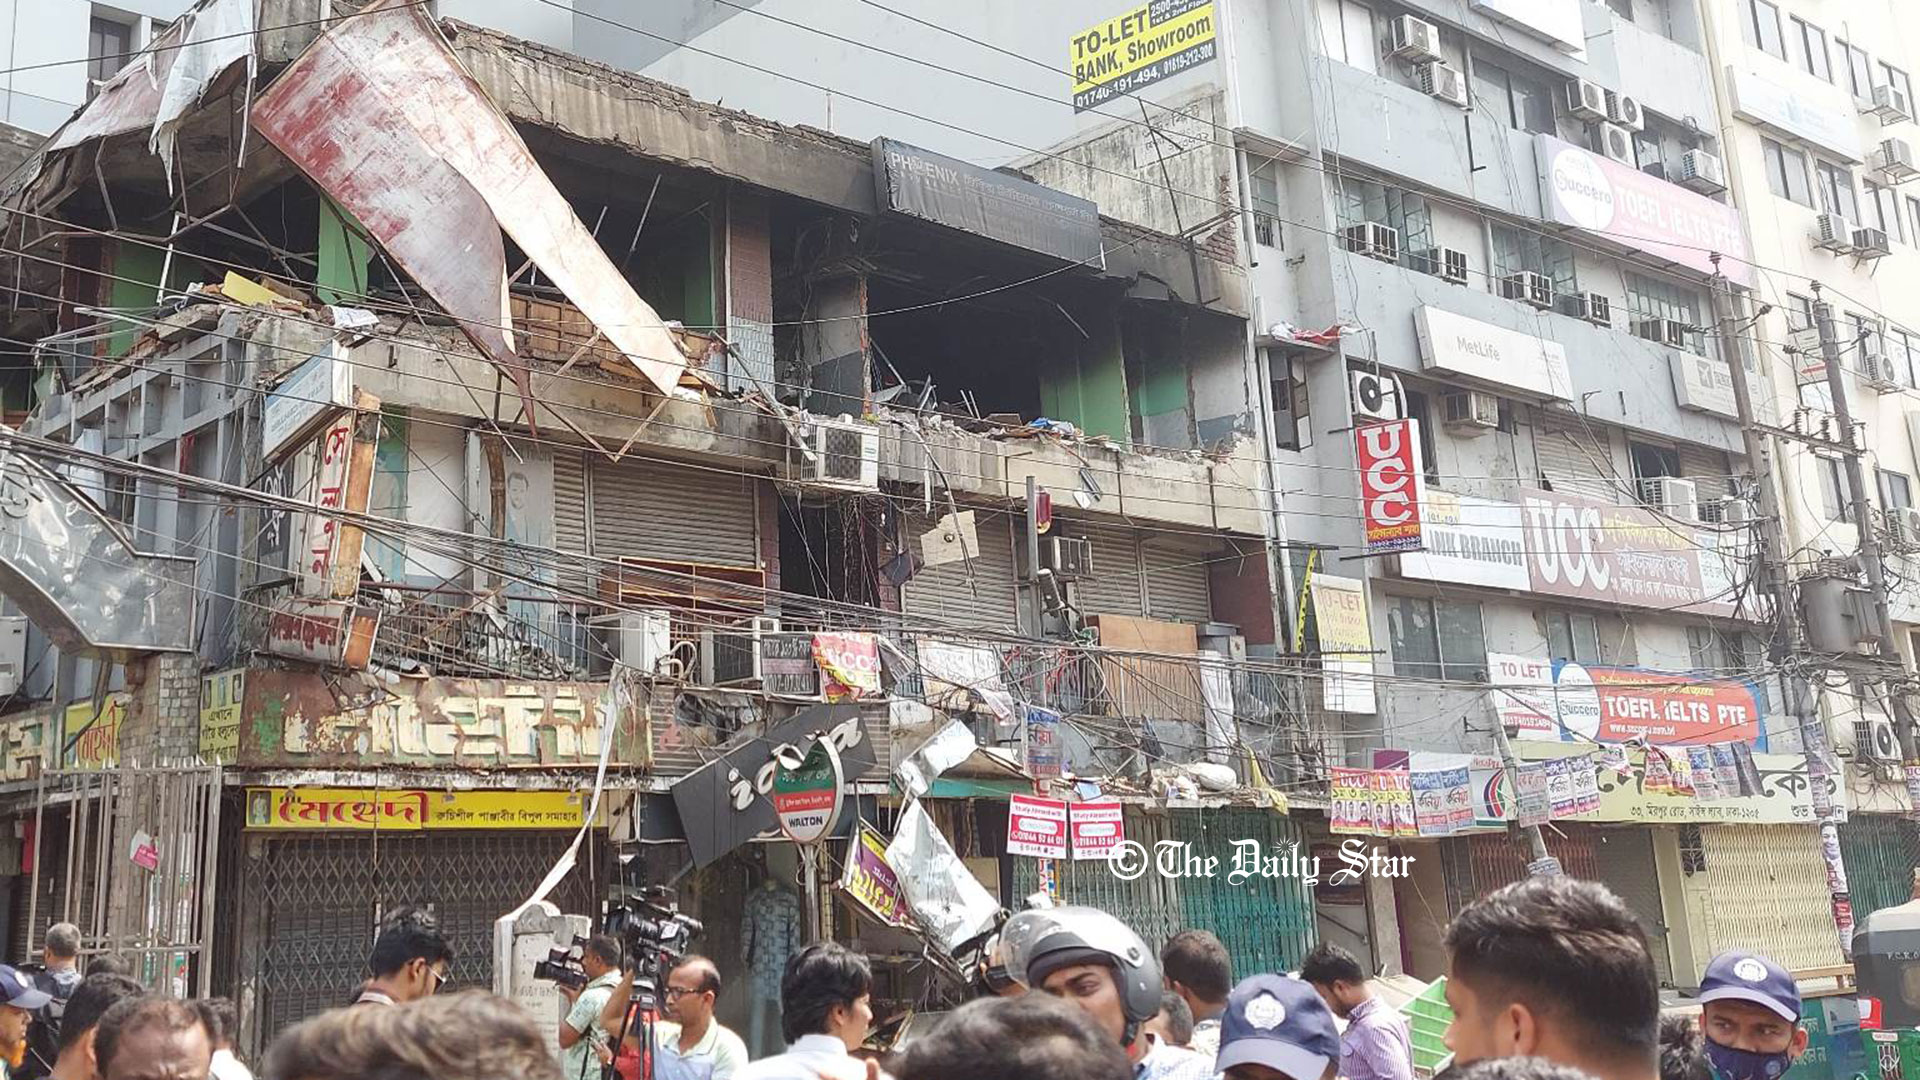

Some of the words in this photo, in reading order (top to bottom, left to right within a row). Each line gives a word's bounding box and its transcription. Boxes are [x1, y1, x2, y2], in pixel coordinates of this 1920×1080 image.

[1073, 9, 1147, 59] TO-LET
[1076, 50, 1123, 86] BANK,
[1127, 15, 1211, 64] Showroom
[1554, 168, 1612, 204] Succero
[1456, 336, 1501, 362] MetLife
[1361, 423, 1412, 526] UCC
[1459, 534, 1522, 566] BRANCH
[1525, 496, 1611, 597] UCC
[1500, 662, 1517, 677] TO
[1520, 661, 1542, 680] LET
[1559, 700, 1599, 716] Succero
[1664, 699, 1711, 724] IELTS
[1716, 703, 1750, 726] PTE
[279, 790, 429, 825] মেহেদী
[518, 808, 543, 823] বিপুল
[788, 815, 823, 828] WALTON
